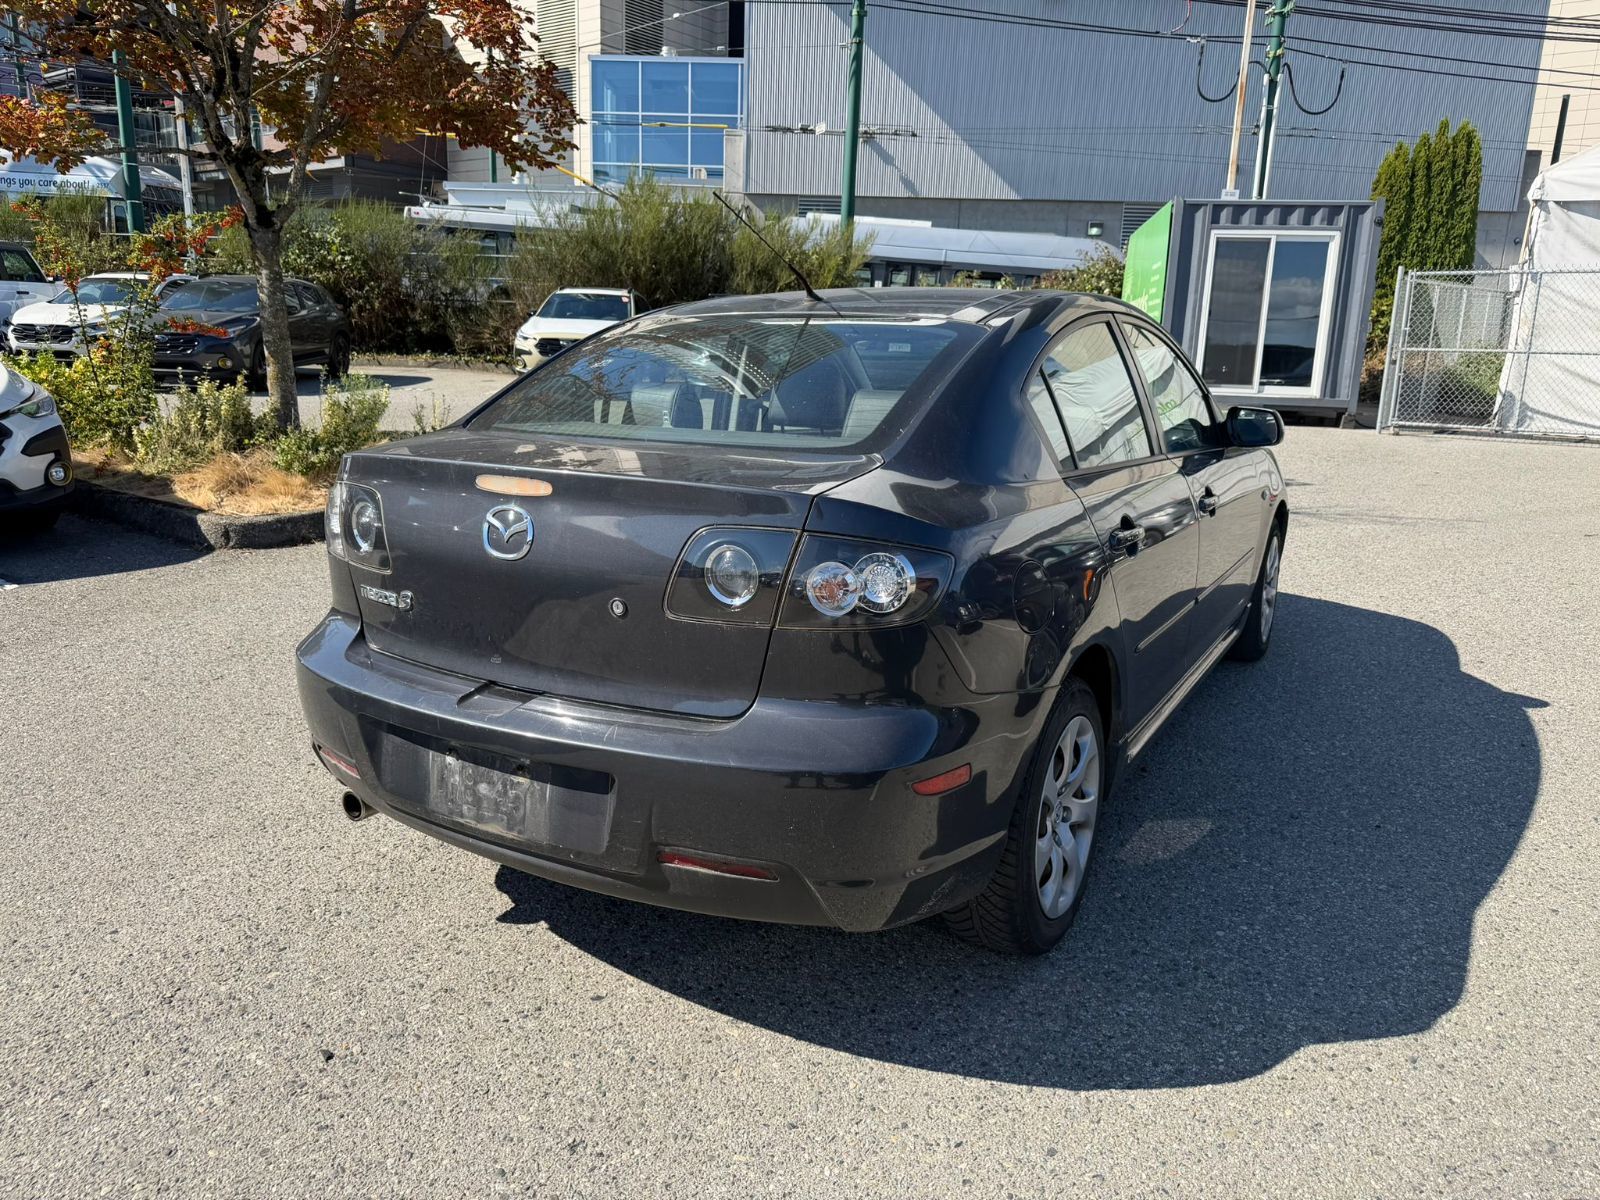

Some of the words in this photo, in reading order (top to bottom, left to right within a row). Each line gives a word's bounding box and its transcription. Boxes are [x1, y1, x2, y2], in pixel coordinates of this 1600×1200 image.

[18, 178, 36, 189] you
[38, 179, 58, 187] care
[60, 179, 90, 189] about!
